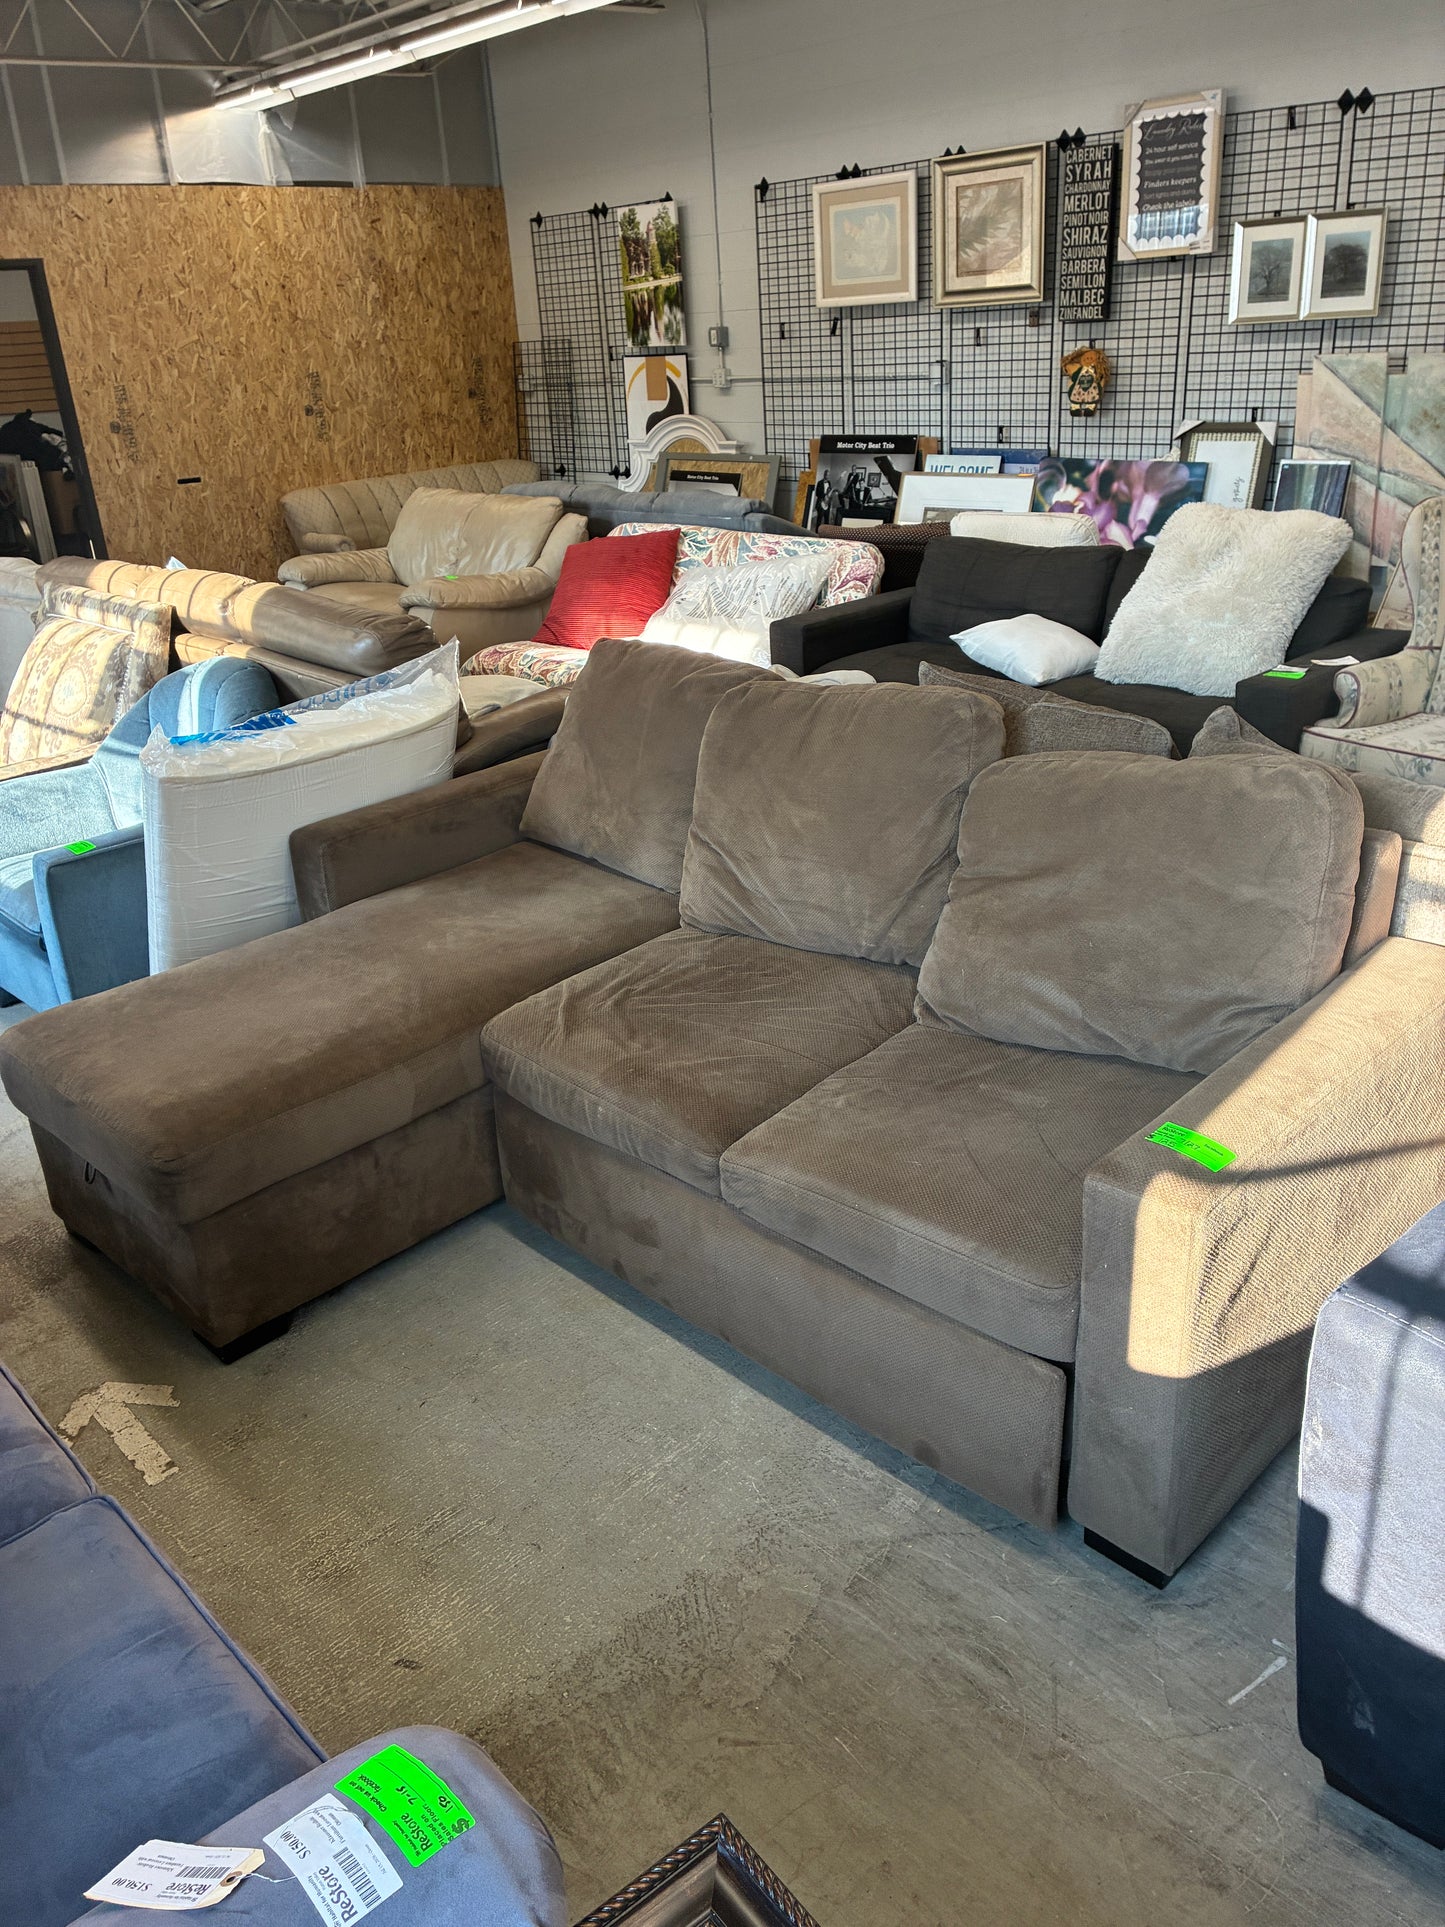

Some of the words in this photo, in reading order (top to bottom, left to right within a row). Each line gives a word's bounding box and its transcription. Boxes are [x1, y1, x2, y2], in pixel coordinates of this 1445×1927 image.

[1066, 145, 1112, 163] CABERNET
[1066, 160, 1112, 182] SYRAH
[1065, 180, 1111, 194] CHARDONNAY
[1144, 180, 1170, 188] Finders
[1171, 177, 1196, 186] keepers
[1064, 192, 1110, 212] MERLOT
[1064, 212, 1088, 227] PINOT
[1088, 210, 1109, 224] NOIR
[1063, 226, 1108, 246] SHIRAZ
[1062, 245, 1107, 259] SAUVIGNON
[1062, 258, 1106, 274] BARBERA
[1061, 274, 1105, 289] SEMILLON
[1060, 289, 1104, 306] MALBEC
[1059, 306, 1103, 320] ZINFANDEL
[854, 442, 867, 450] City
[358, 1774, 382, 1792] facebook
[422, 1804, 439, 1822] Floor:
[438, 1796, 453, 1813] 150
[421, 1815, 429, 1823] on
[452, 1818, 470, 1834] $
[401, 1813, 433, 1852] ReStore
[428, 1824, 447, 1847] Placed
[439, 1822, 454, 1841] Sales
[112, 1877, 152, 1892] $150.00
[166, 1882, 212, 1896] ReStore
[318, 1866, 358, 1922] ReStore
